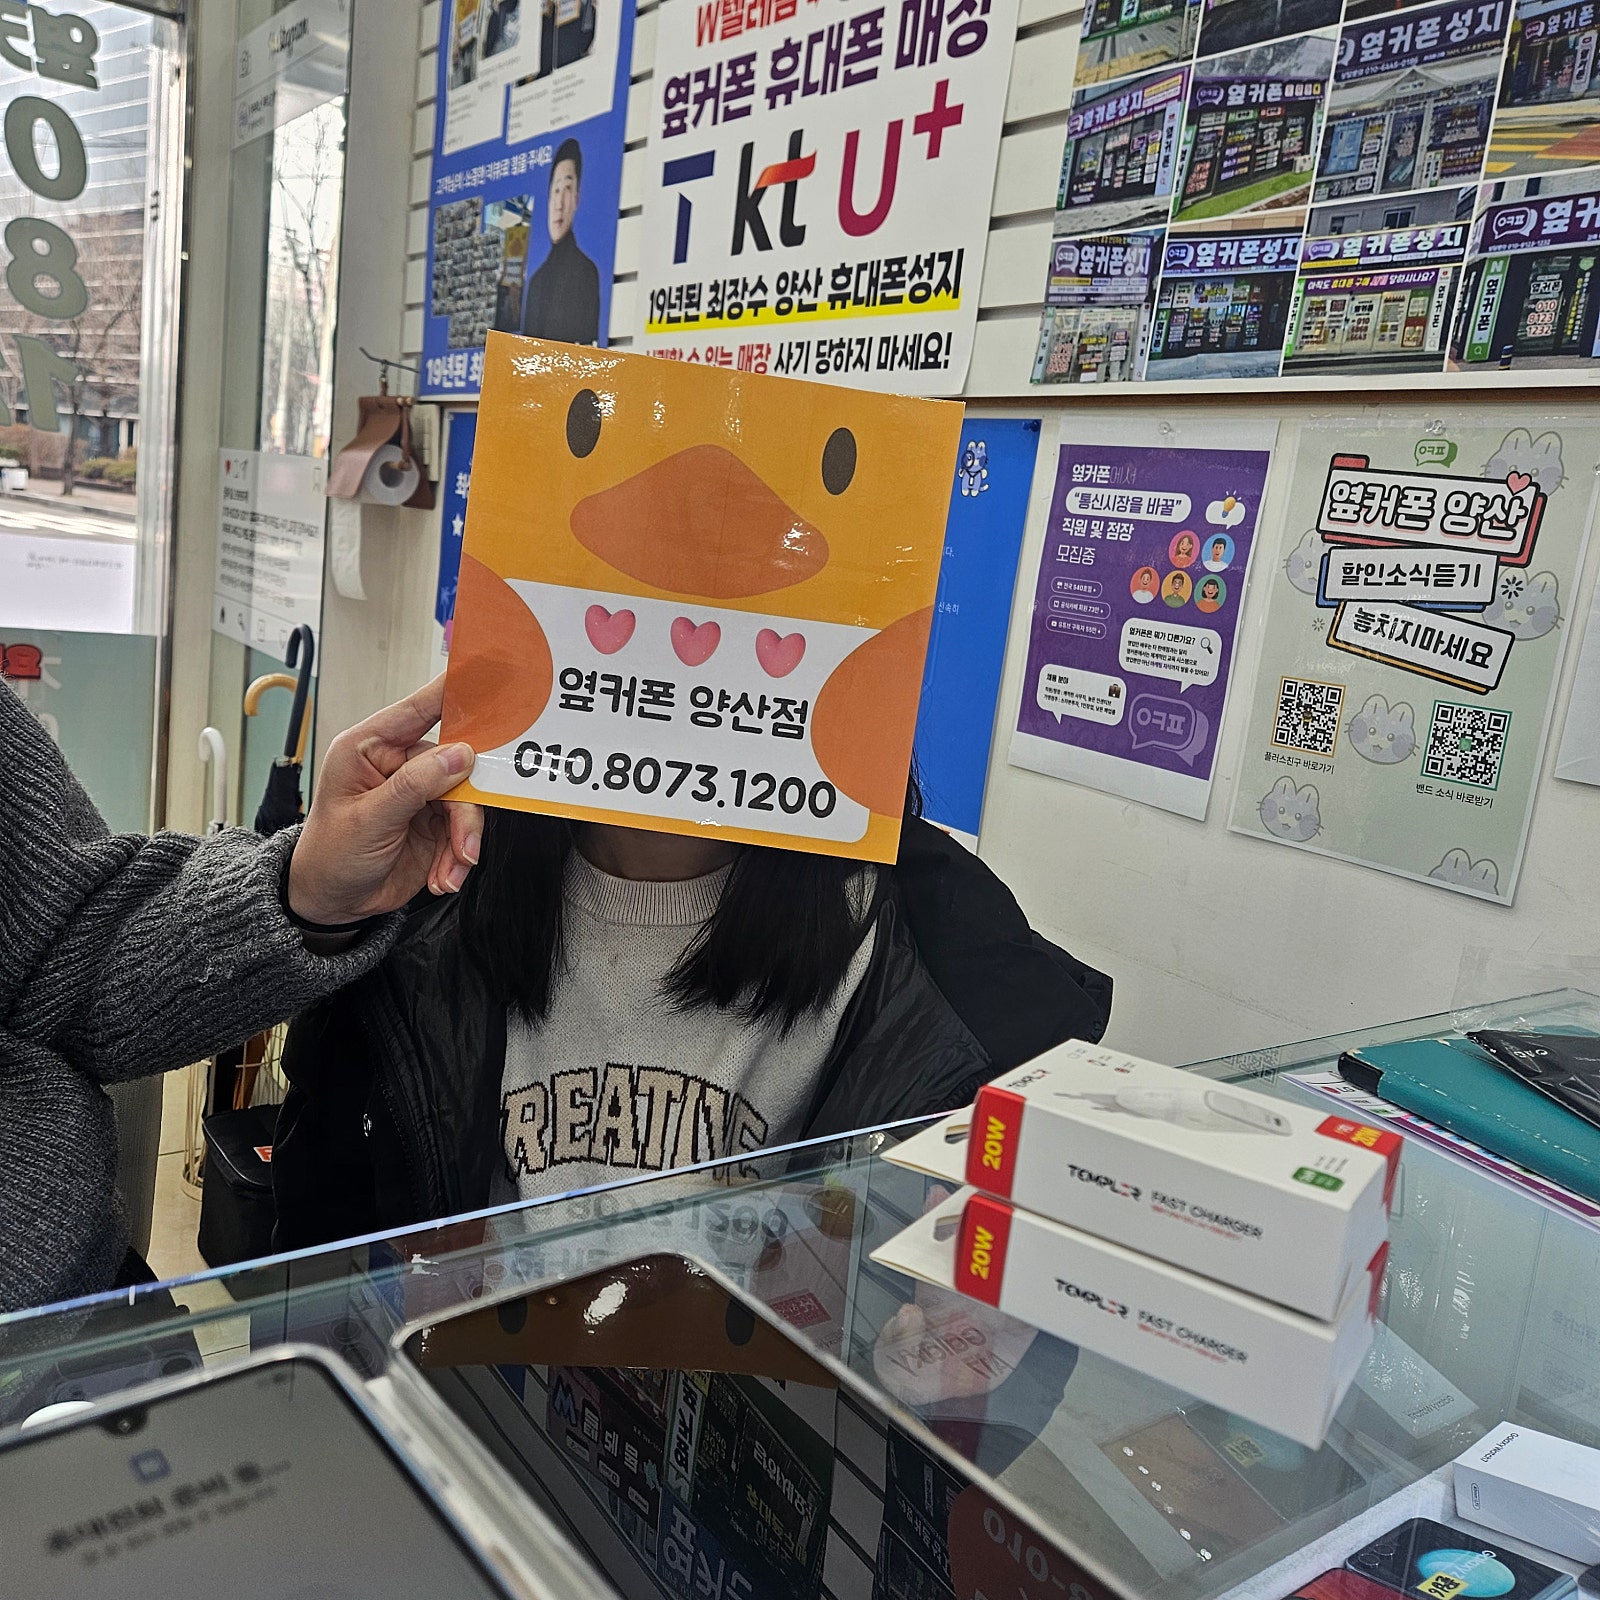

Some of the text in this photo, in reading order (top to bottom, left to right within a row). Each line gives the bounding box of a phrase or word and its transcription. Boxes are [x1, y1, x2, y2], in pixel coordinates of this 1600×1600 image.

[662, 51, 757, 139] 옆커폰
[765, 6, 886, 110] 휴대폰
[837, 78, 964, 236] U+
[730, 129, 816, 256] kt
[649, 248, 964, 325] 19년된 최장수 양산 휴대폰성지
[774, 340, 810, 374] 사기
[815, 336, 873, 374] 당하지
[876, 331, 952, 371] 마세요!
[1062, 518, 1135, 541] 직원 및 점장
[1327, 480, 1529, 541] 옆커폰 양산
[1056, 544, 1096, 565] 모집중
[1341, 562, 1482, 588] 할인소식듣기
[1353, 607, 1493, 669] 놓치지마세요
[558, 666, 809, 741] 옆커폰 양산점
[514, 740, 836, 819] 010.8073.1200
[1264, 751, 1335, 775] 플러스친구 바로가기
[1415, 783, 1494, 809] 밴드 소식 바로받기
[983, 1116, 1007, 1171] 20W
[1151, 1190, 1187, 1212] FAST
[1190, 1205, 1264, 1240] CHARGER
[970, 1225, 995, 1280] 20W
[1138, 1309, 1174, 1332] FAST
[1176, 1326, 1248, 1365] CHARGER
